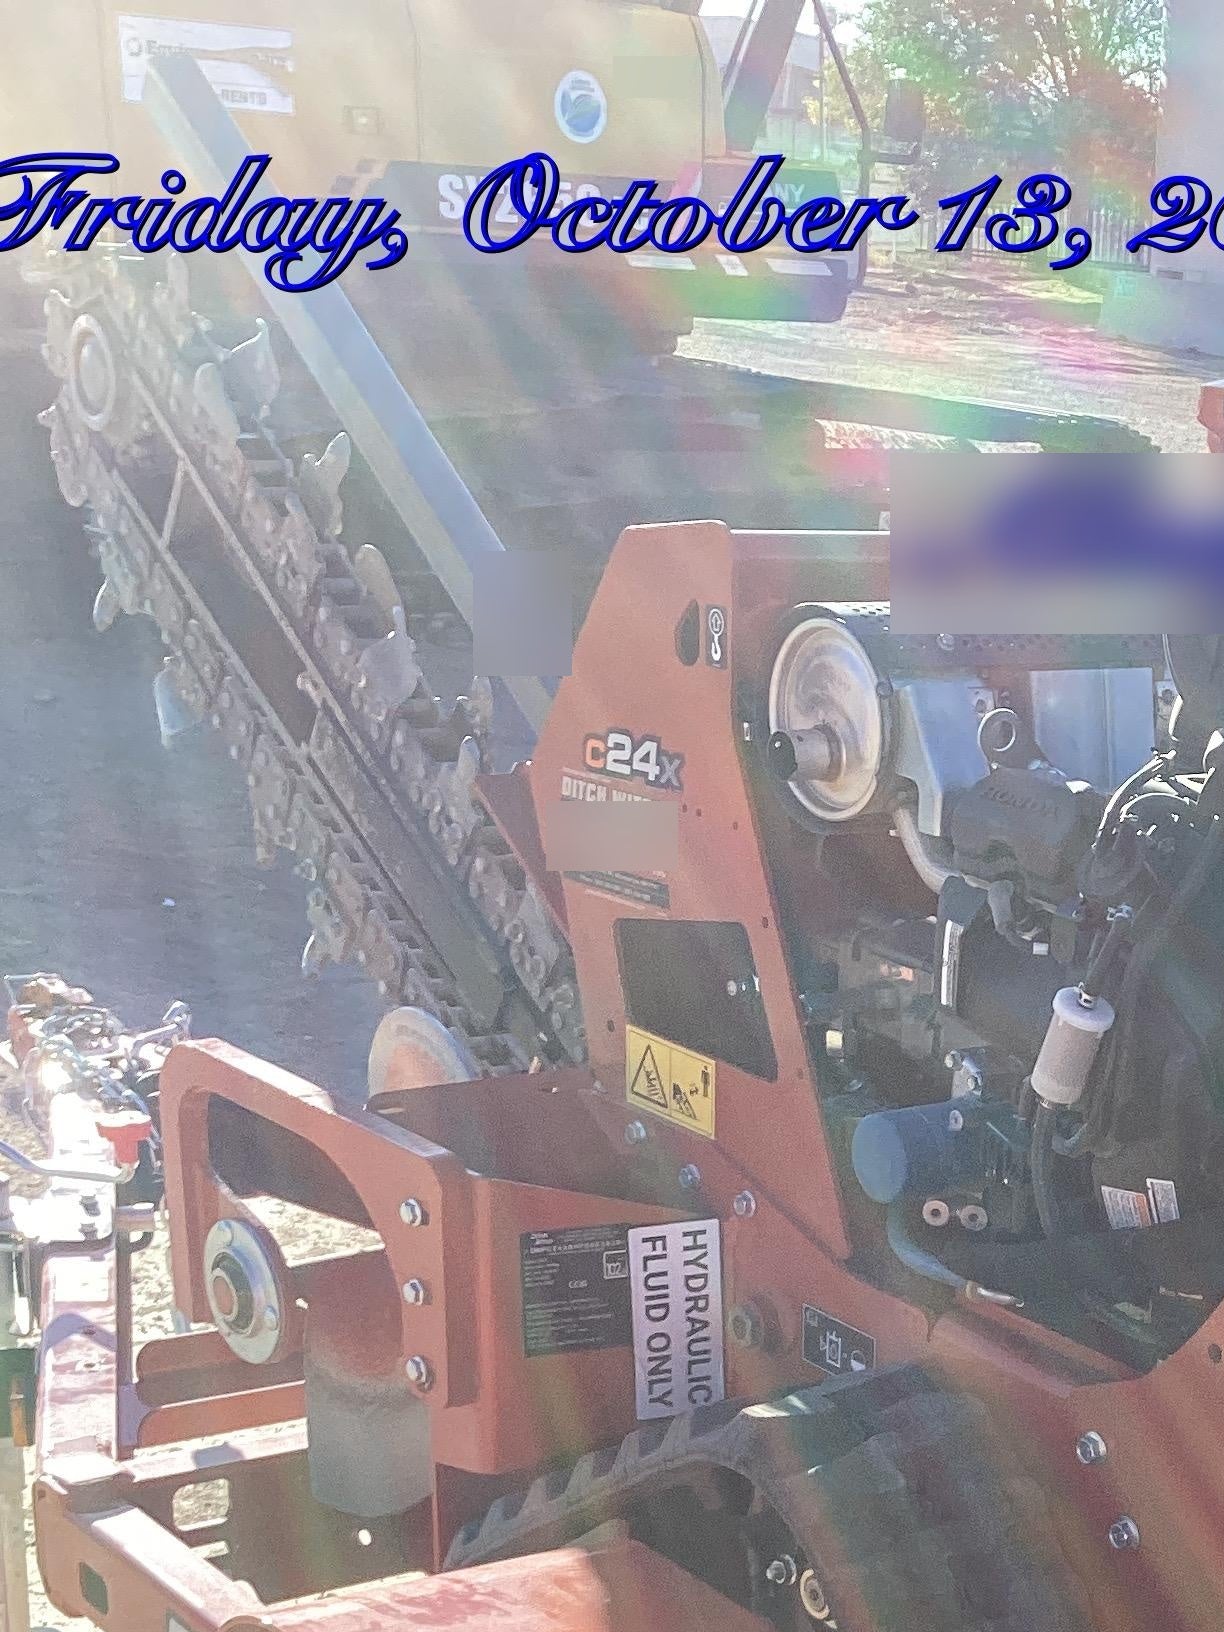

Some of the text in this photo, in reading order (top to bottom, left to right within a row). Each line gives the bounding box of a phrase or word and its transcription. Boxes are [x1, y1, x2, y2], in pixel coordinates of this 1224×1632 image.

[642, 1235, 674, 1408] FLUID ONLY
[682, 1229, 713, 1405] HYDRAULIC
